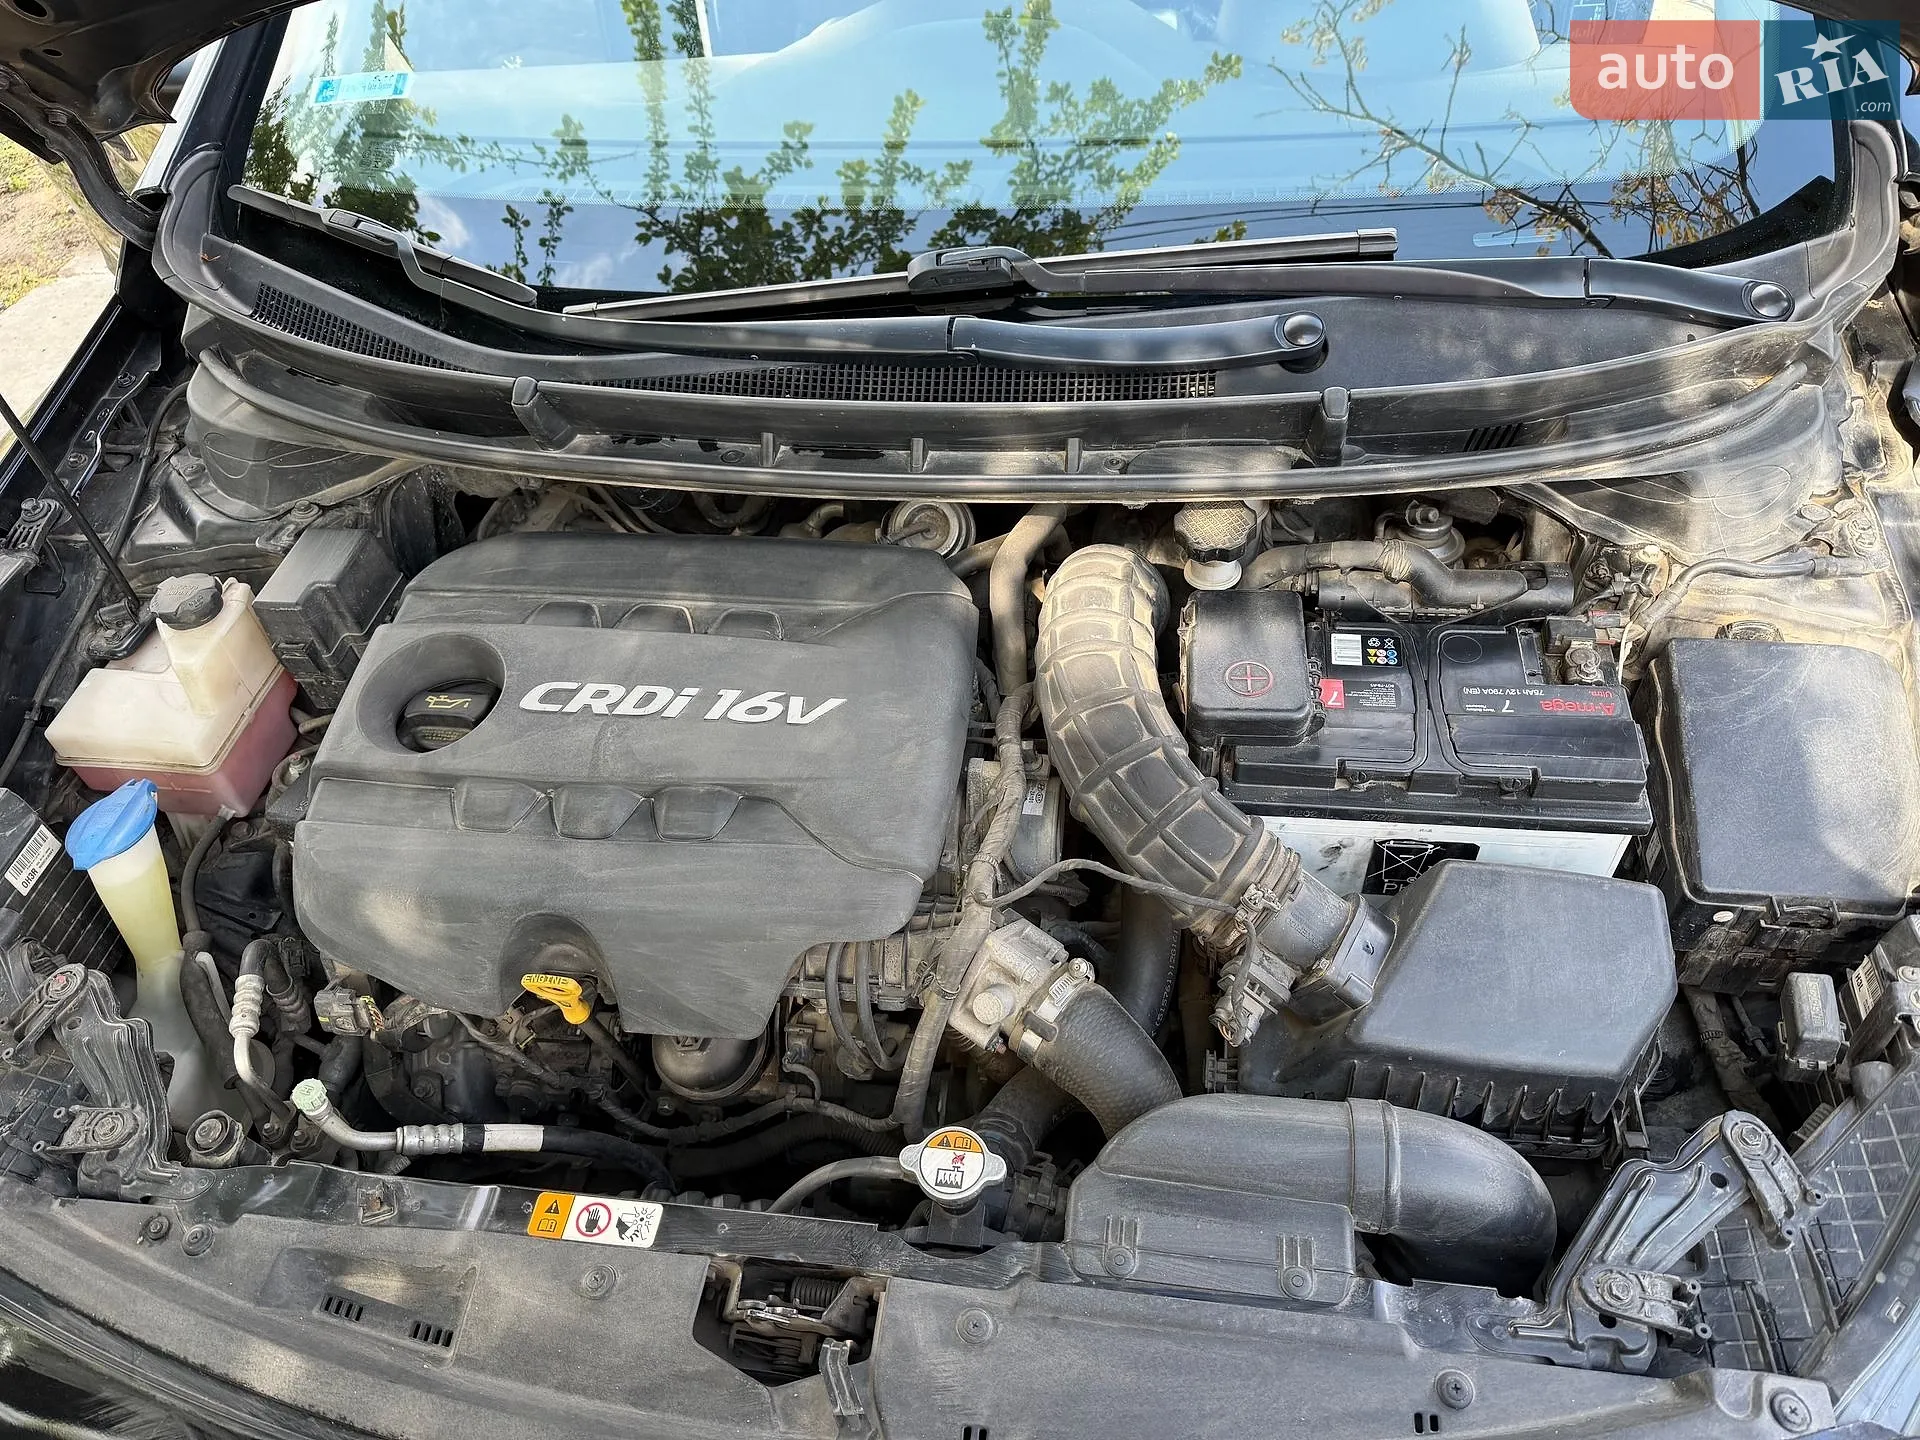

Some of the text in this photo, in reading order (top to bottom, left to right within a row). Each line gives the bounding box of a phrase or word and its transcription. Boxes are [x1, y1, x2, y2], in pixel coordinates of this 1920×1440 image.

[1463, 686, 1481, 695] (EN)
[519, 681, 847, 725] CRDi 16V
[1327, 690, 1342, 706] 7
[1501, 699, 1515, 713] 7
[523, 974, 569, 985] ENGINE
